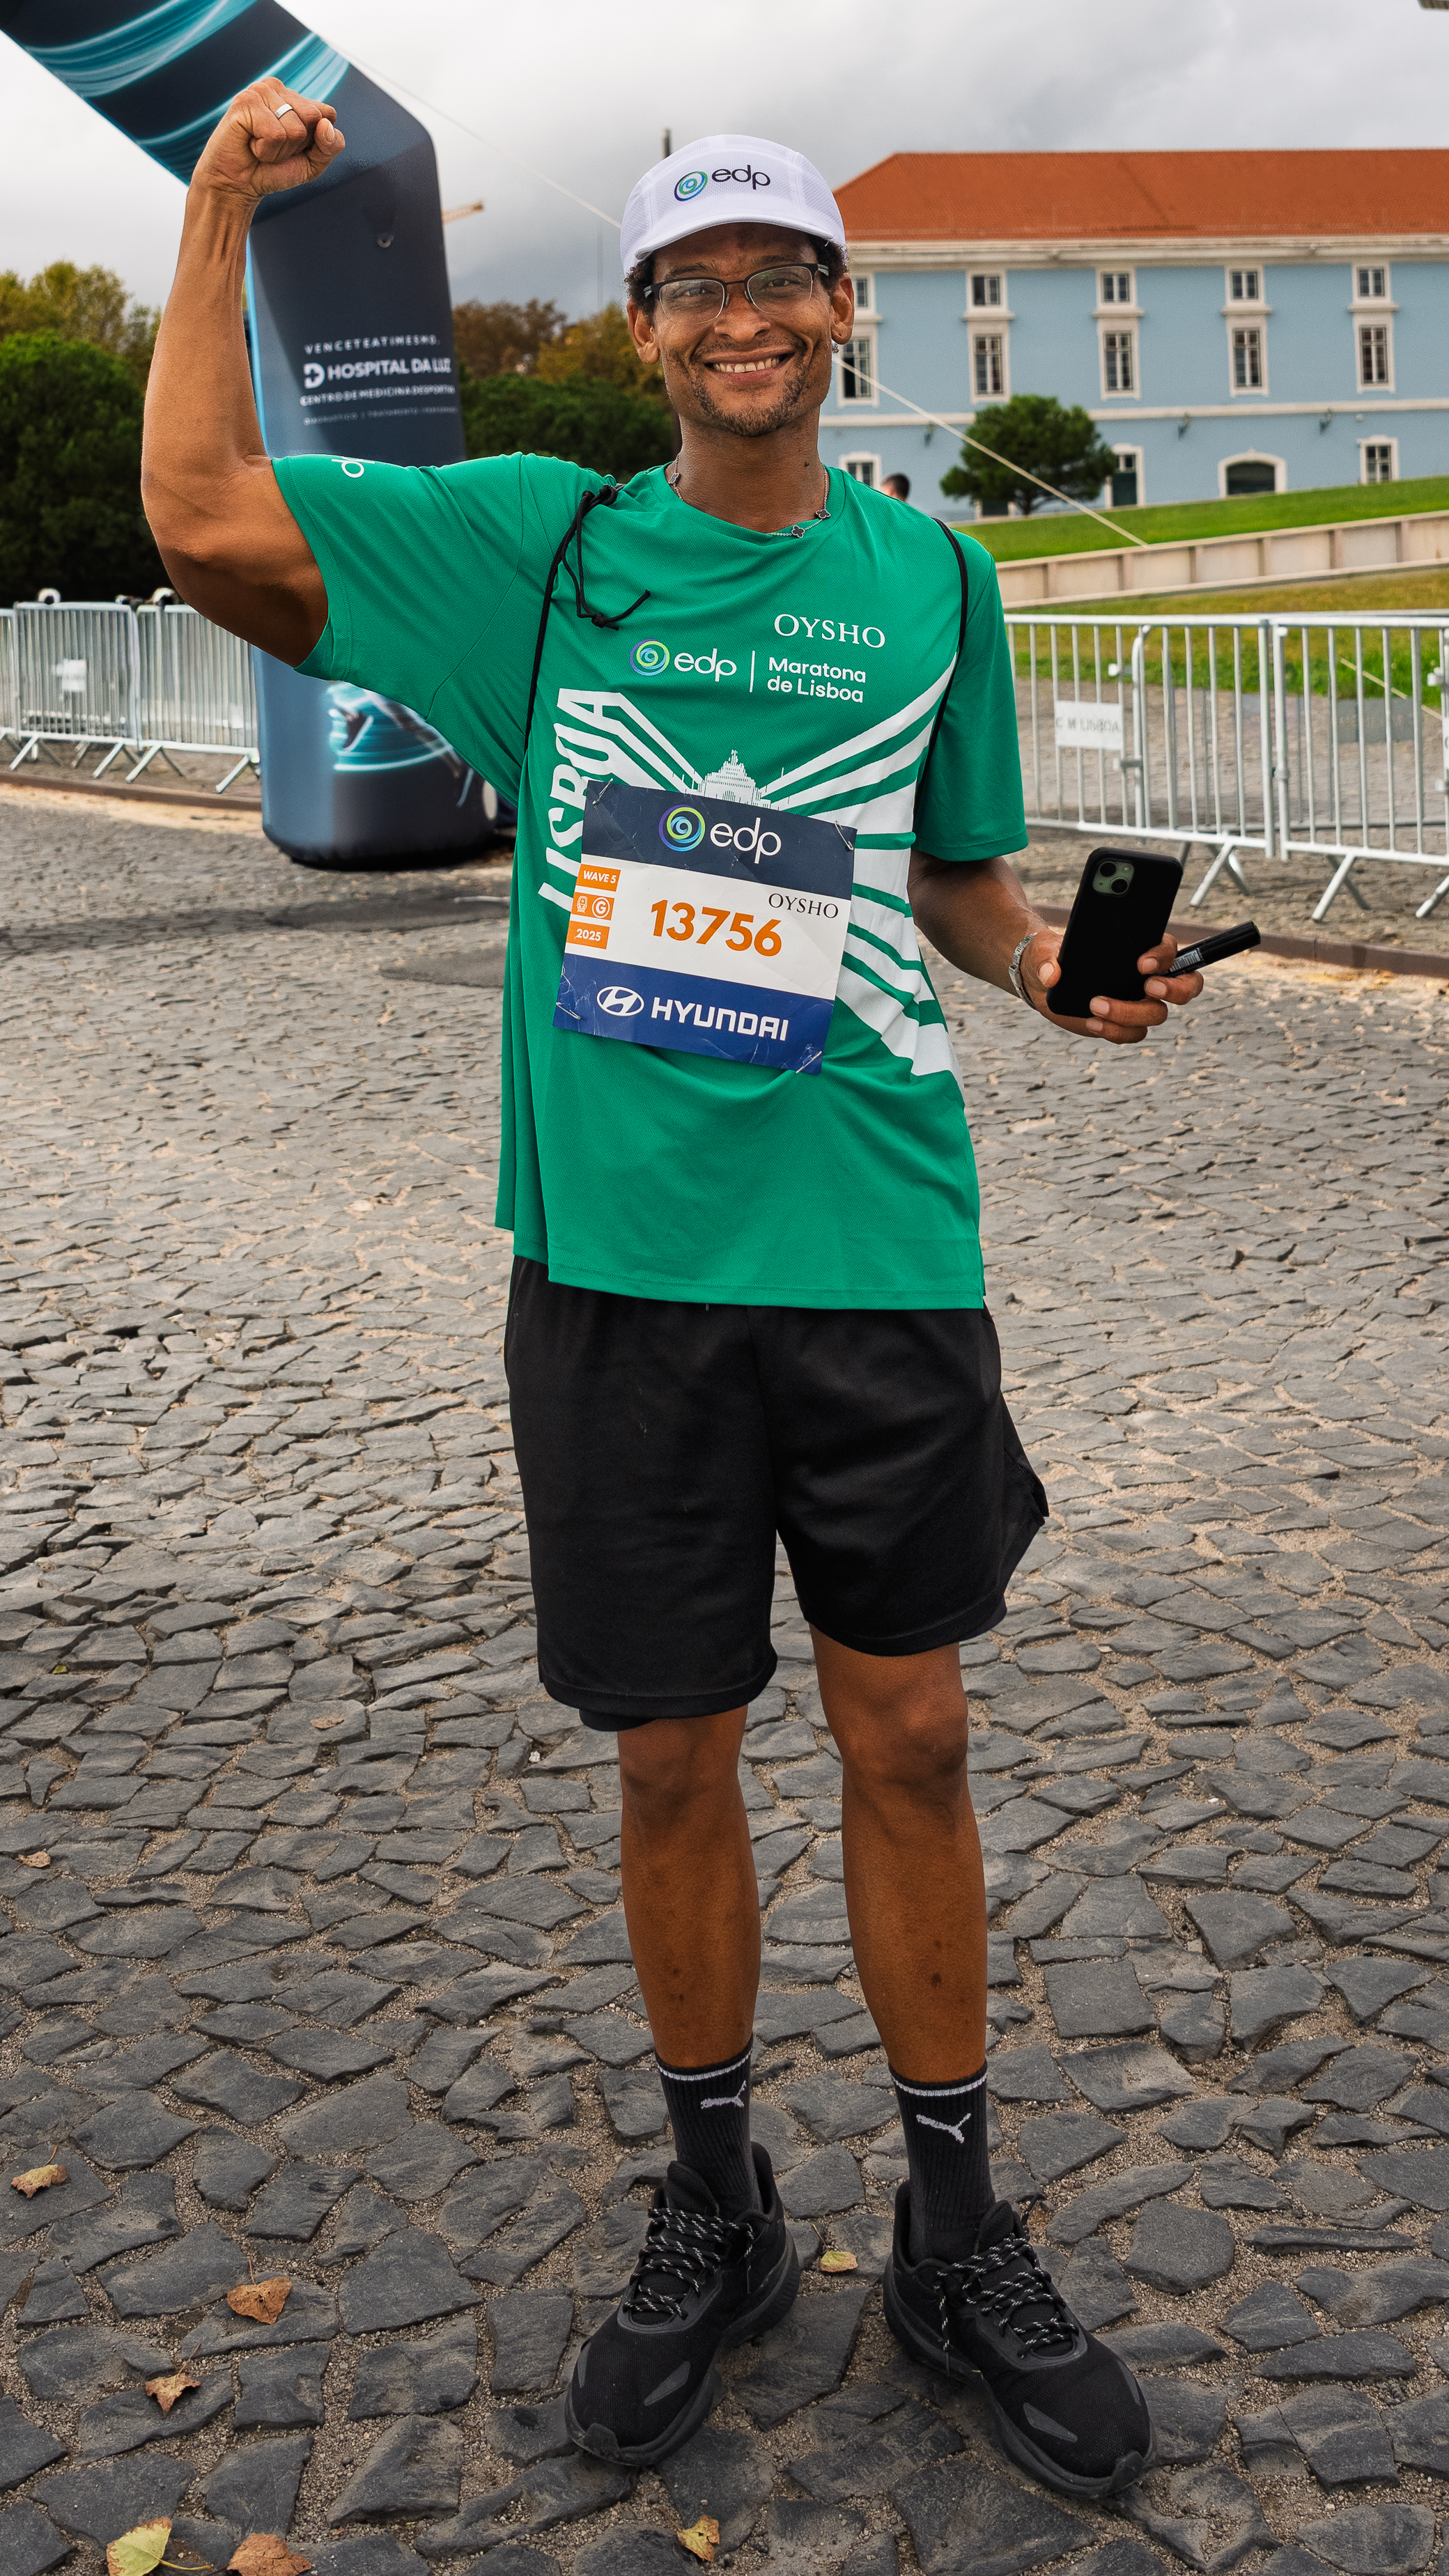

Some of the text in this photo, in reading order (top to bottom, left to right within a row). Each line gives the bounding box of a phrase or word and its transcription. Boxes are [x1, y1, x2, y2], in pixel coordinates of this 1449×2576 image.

[711, 164, 770, 190] edp
[327, 359, 410, 380] HOSPITAL
[773, 613, 886, 649] OYSHO
[674, 648, 738, 682] edp
[768, 656, 867, 683] Maratona
[766, 676, 864, 704] de Lisboa
[709, 817, 782, 864] edp
[583, 870, 617, 884] WAVE 5
[596, 900, 607, 915] G
[768, 892, 839, 920] OYSHO
[575, 928, 601, 942] 2025
[651, 899, 782, 957] 13756
[651, 996, 789, 1041] HYUNDAI
